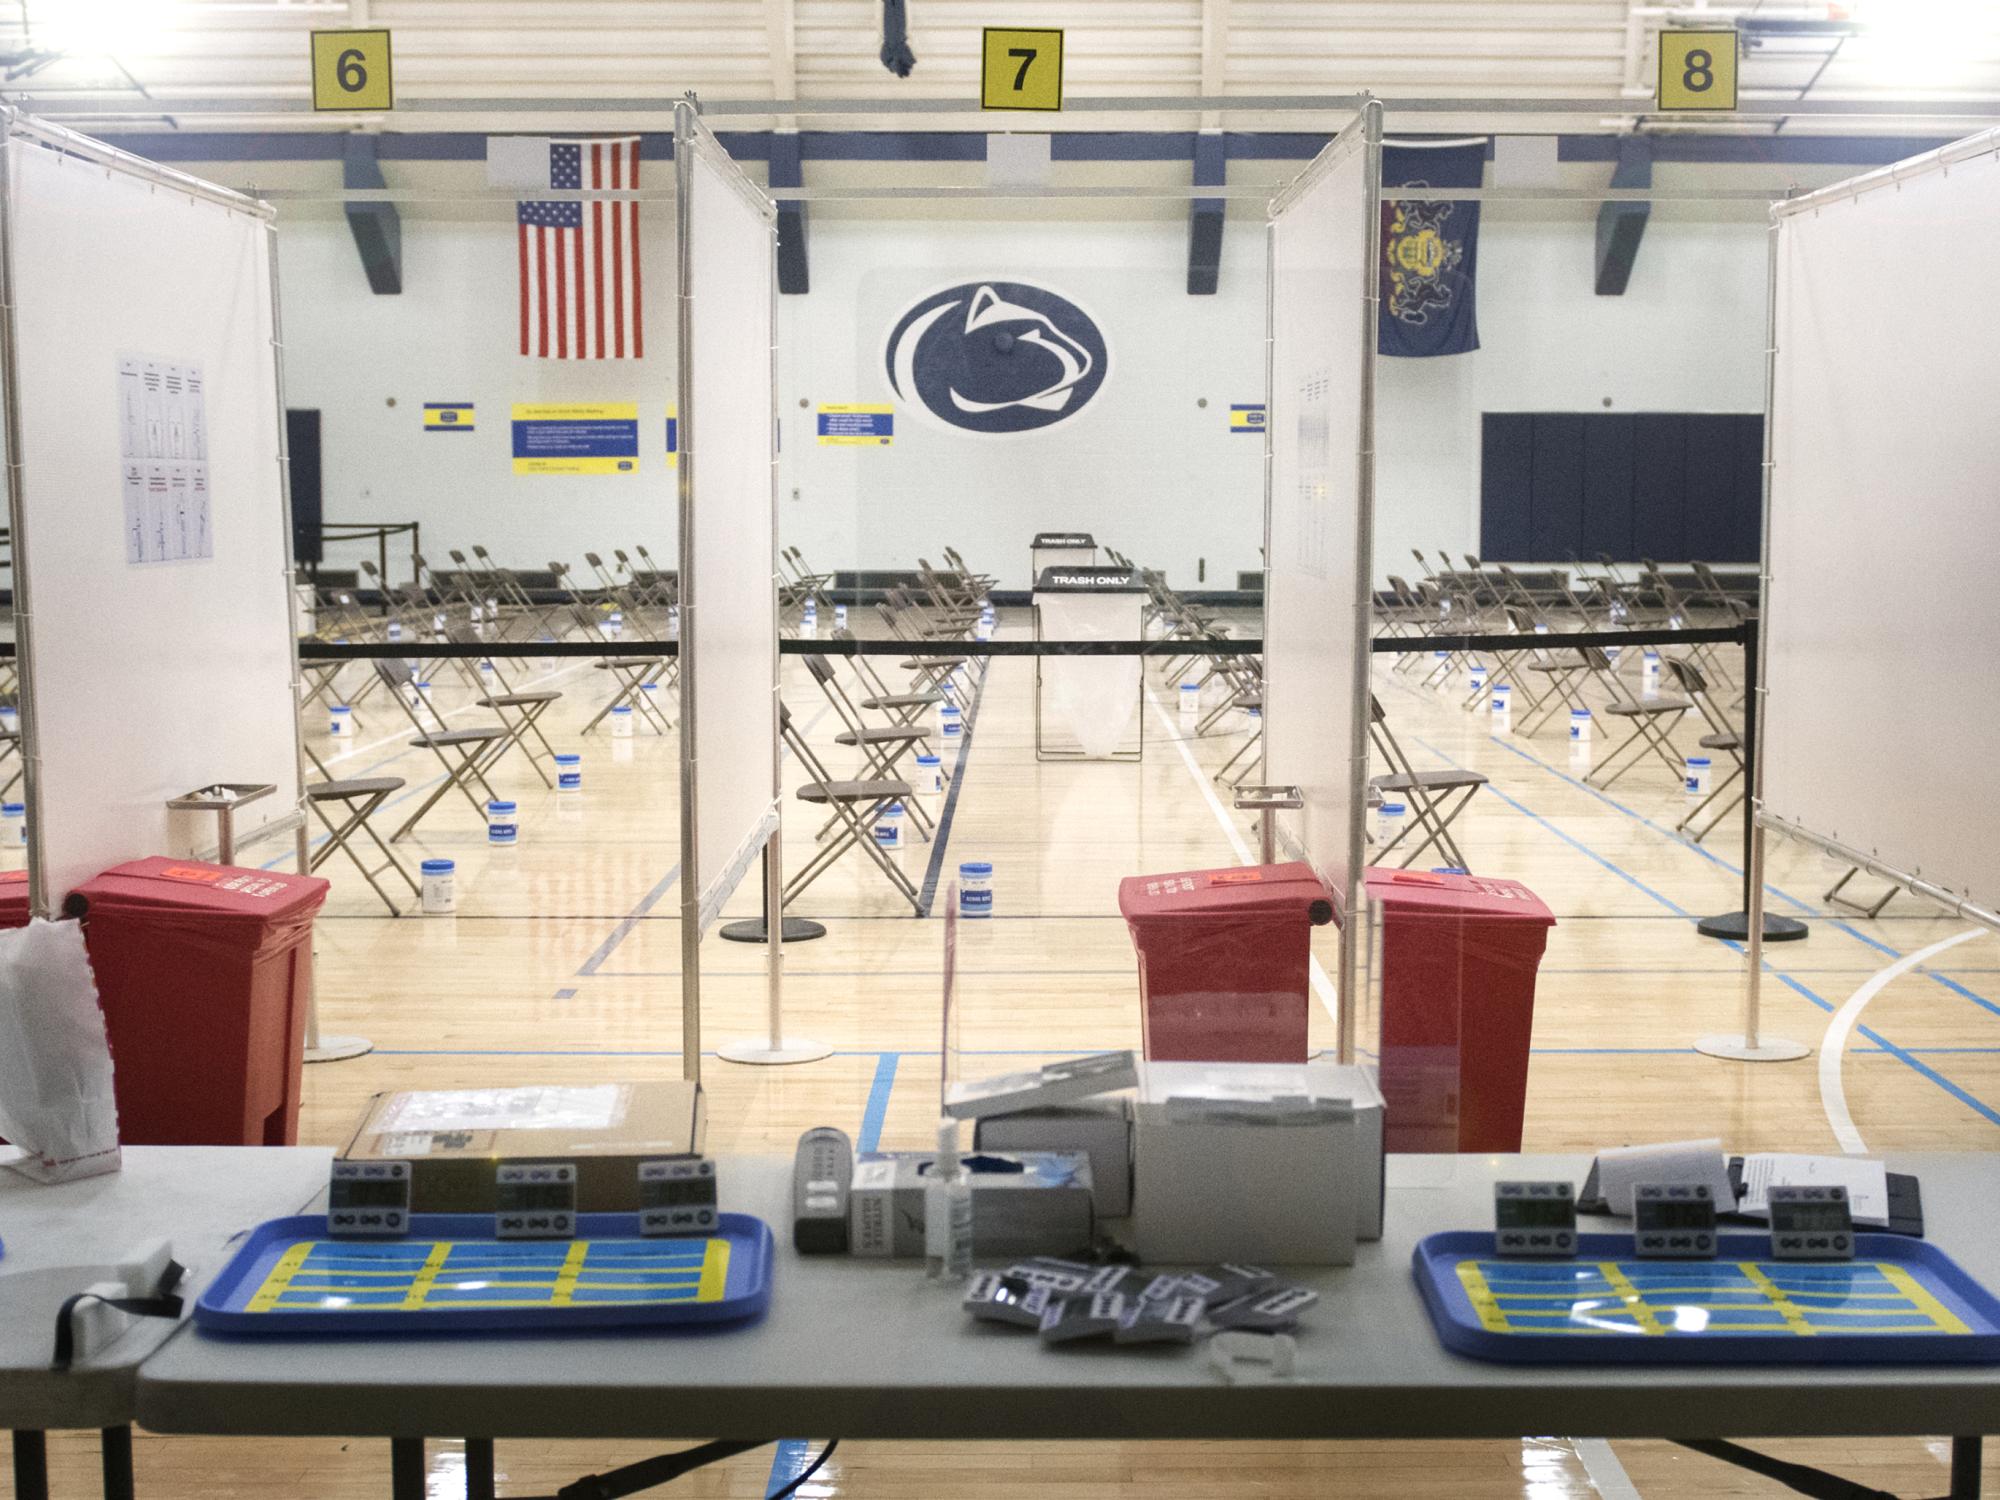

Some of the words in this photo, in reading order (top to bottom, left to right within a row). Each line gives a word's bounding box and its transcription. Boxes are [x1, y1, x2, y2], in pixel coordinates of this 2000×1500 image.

[336, 48, 367, 93] 6
[1008, 48, 1037, 91] 7
[1683, 48, 1714, 93] 8
[1052, 575, 1095, 585] TRASH
[1096, 575, 1130, 585] ONLY
